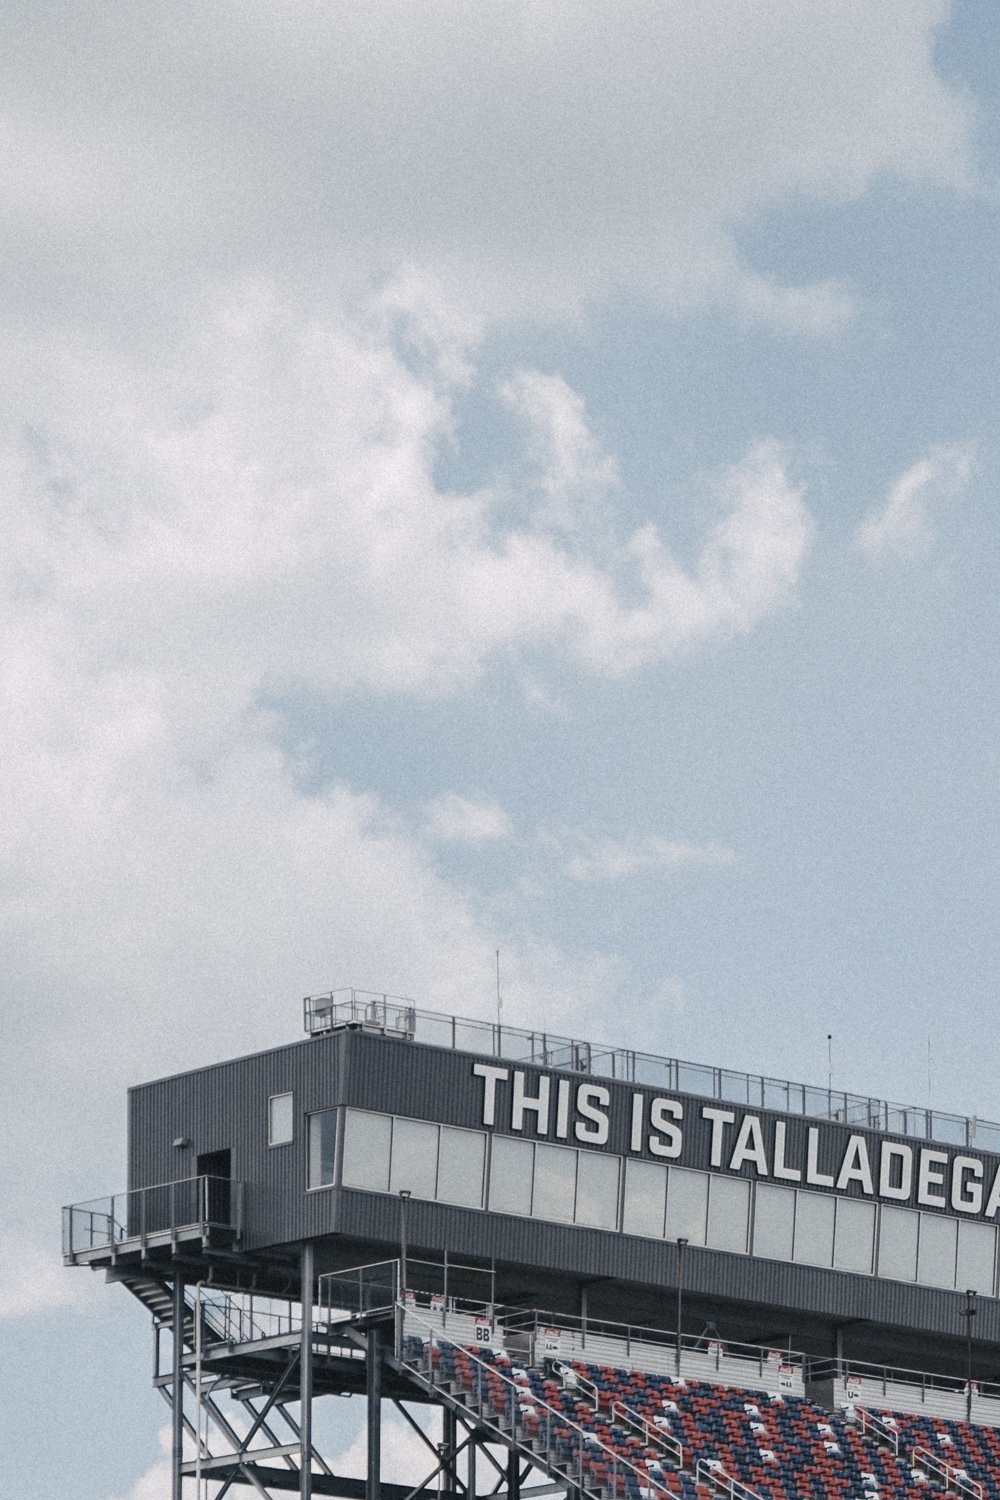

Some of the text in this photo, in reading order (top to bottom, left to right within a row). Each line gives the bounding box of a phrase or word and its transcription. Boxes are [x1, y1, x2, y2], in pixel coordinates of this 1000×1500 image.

[473, 1063, 610, 1146] THIS
[631, 1092, 683, 1159] IS
[476, 1327, 490, 1342] BB
